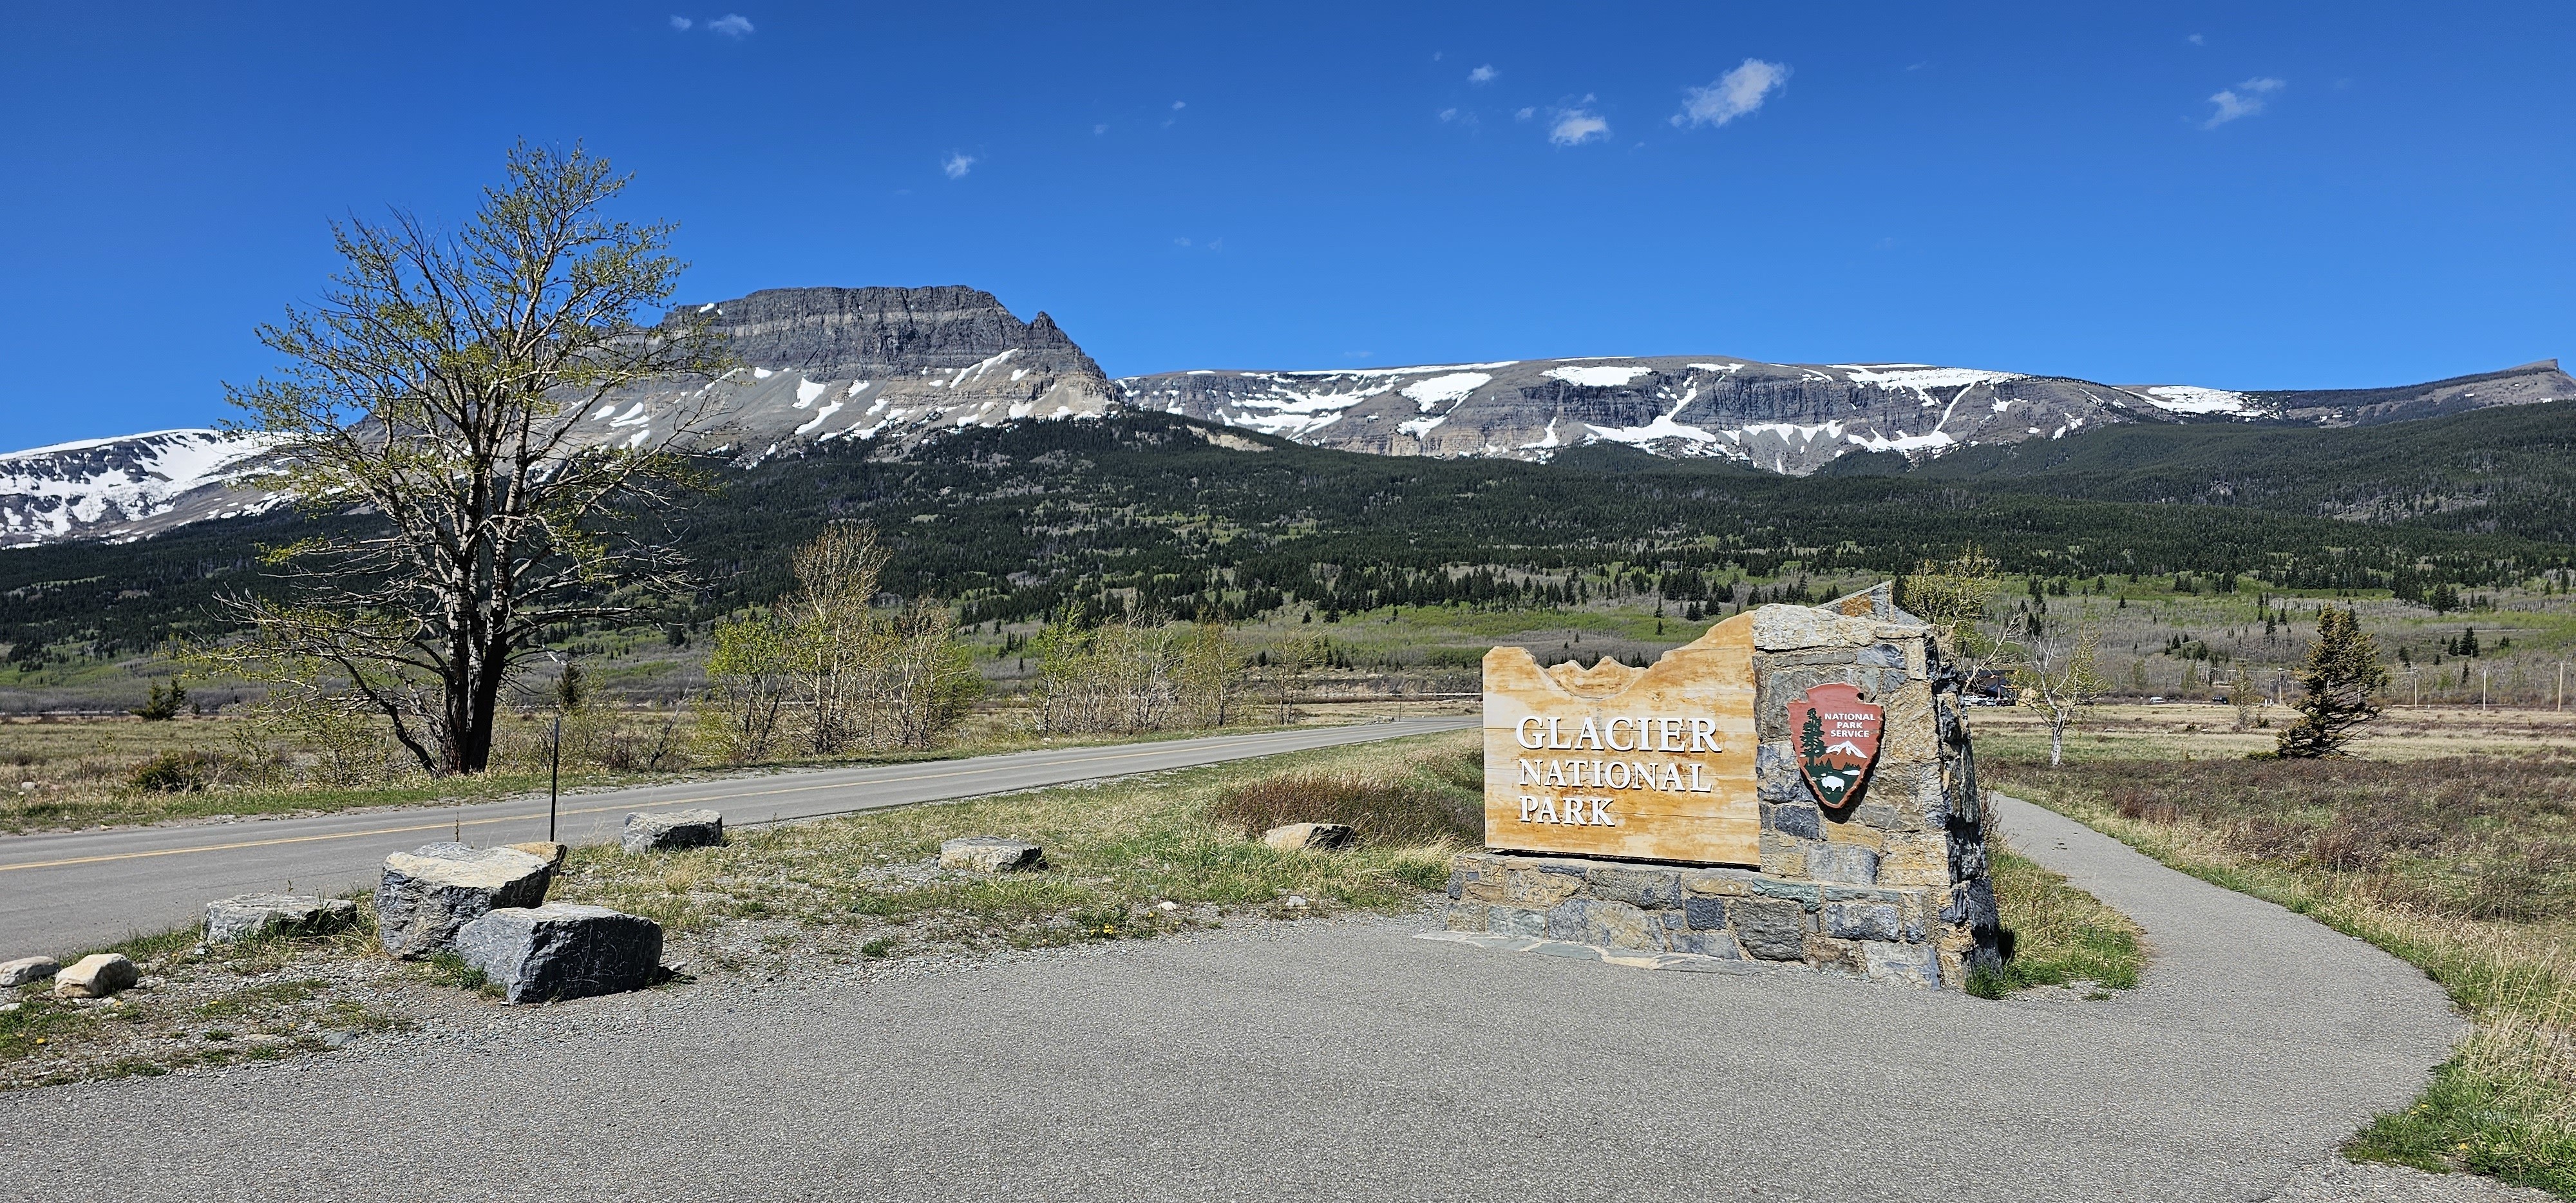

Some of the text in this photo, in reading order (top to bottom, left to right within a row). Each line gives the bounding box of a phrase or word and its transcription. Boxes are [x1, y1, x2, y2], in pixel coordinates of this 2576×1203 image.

[1515, 715, 1722, 753] GLACIER
[1830, 730, 1870, 738] SERVICE
[1519, 759, 1712, 793] NATIONAL
[1519, 795, 1615, 827] PARK
